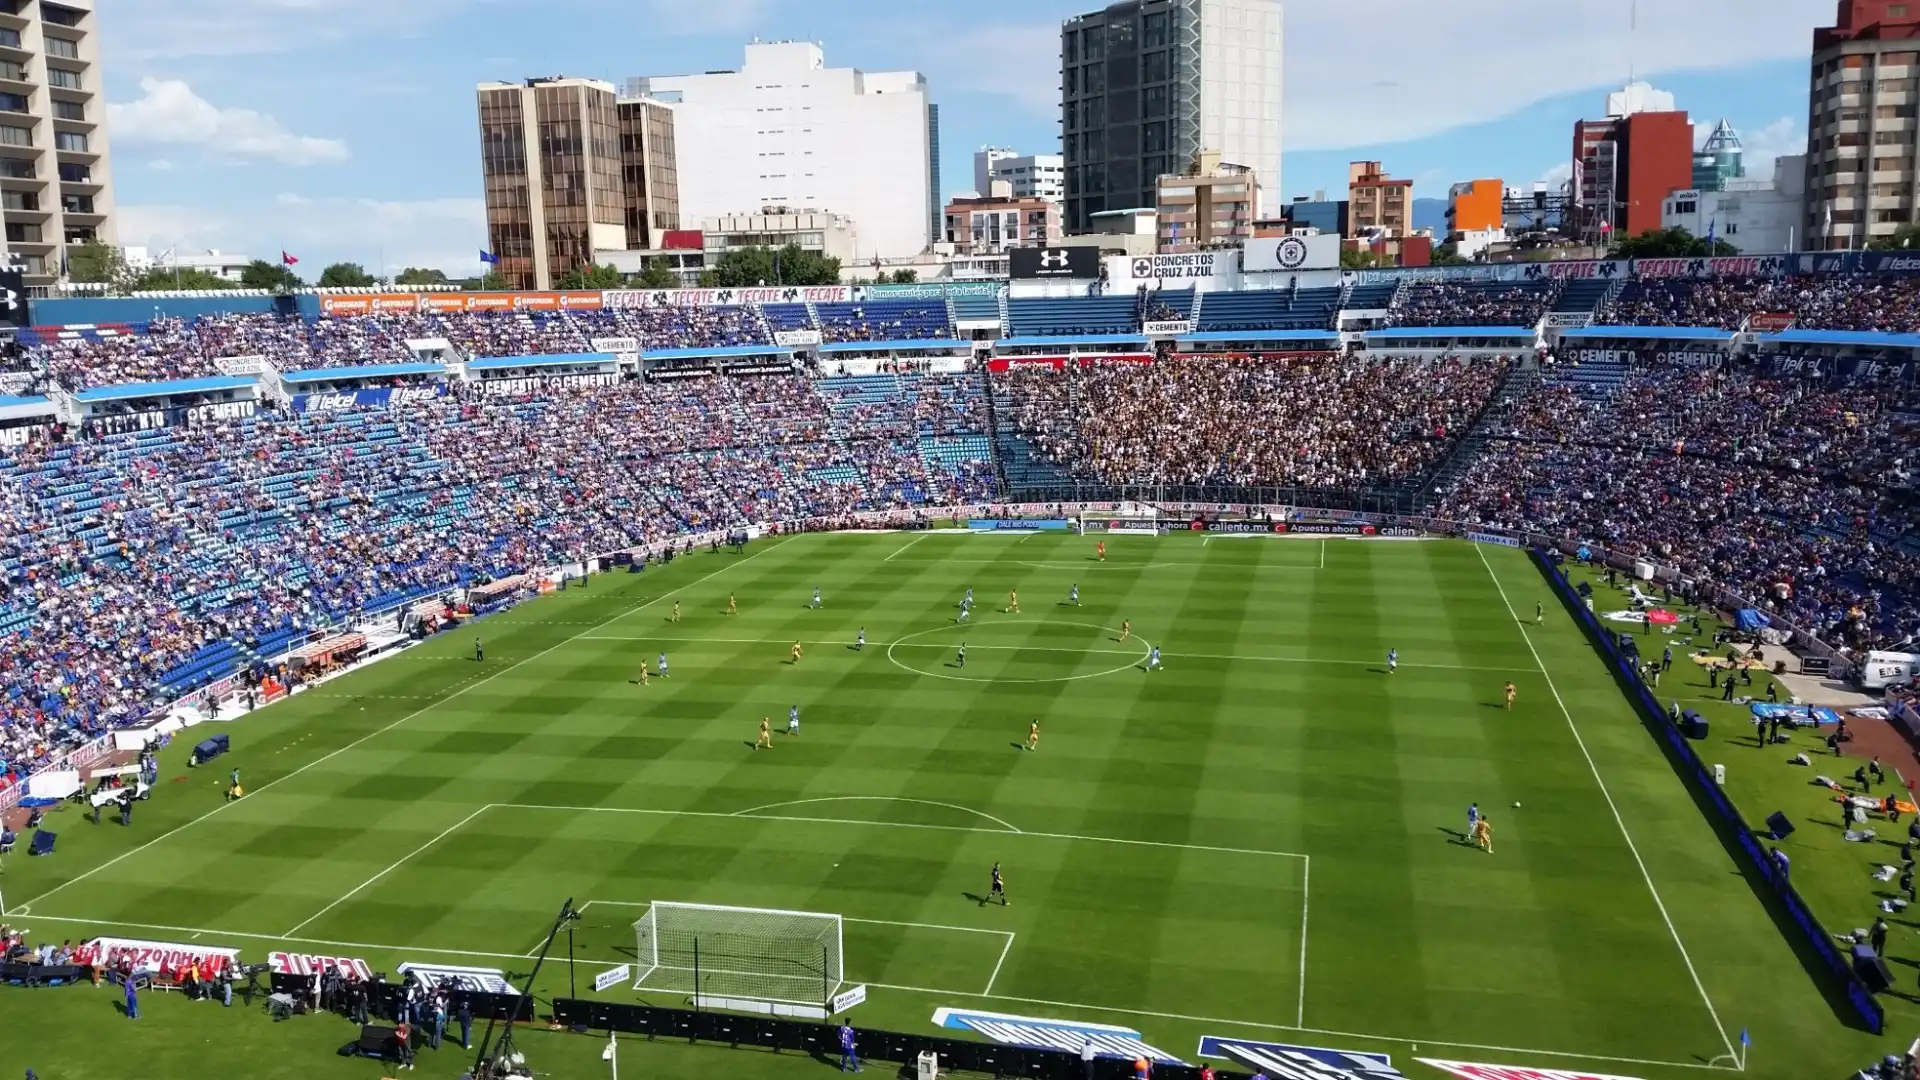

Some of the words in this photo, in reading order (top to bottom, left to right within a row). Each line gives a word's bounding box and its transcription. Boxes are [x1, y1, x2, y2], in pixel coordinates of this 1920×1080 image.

[1153, 253, 1214, 267] CONCRETOS
[1638, 259, 1689, 276] TECATE
[1709, 258, 1760, 275] TECATE
[1889, 257, 1920, 270] telce
[1153, 267, 1183, 278] CRUZ
[1186, 266, 1214, 277] AZUL
[1547, 262, 1597, 277] TECATE
[607, 291, 652, 307] TECATE
[671, 289, 716, 305] TECATE
[735, 288, 783, 303] TECATE
[802, 286, 847, 301] TECATE
[1155, 323, 1188, 332] CEMENTO
[602, 340, 634, 349] CEMENTO
[1667, 351, 1723, 367] CEMENTO
[485, 377, 543, 396] CEMENTO
[563, 372, 620, 390] CEMENTO
[400, 384, 436, 401] telcel
[318, 391, 358, 410] telcel
[1163, 521, 1188, 530] ahora
[1209, 521, 1269, 531] caliente.mx
[1291, 523, 1330, 534] Apuesta
[1331, 525, 1359, 533] ahora
[1381, 525, 1416, 536] calien
[1878, 666, 1902, 677] EMS
